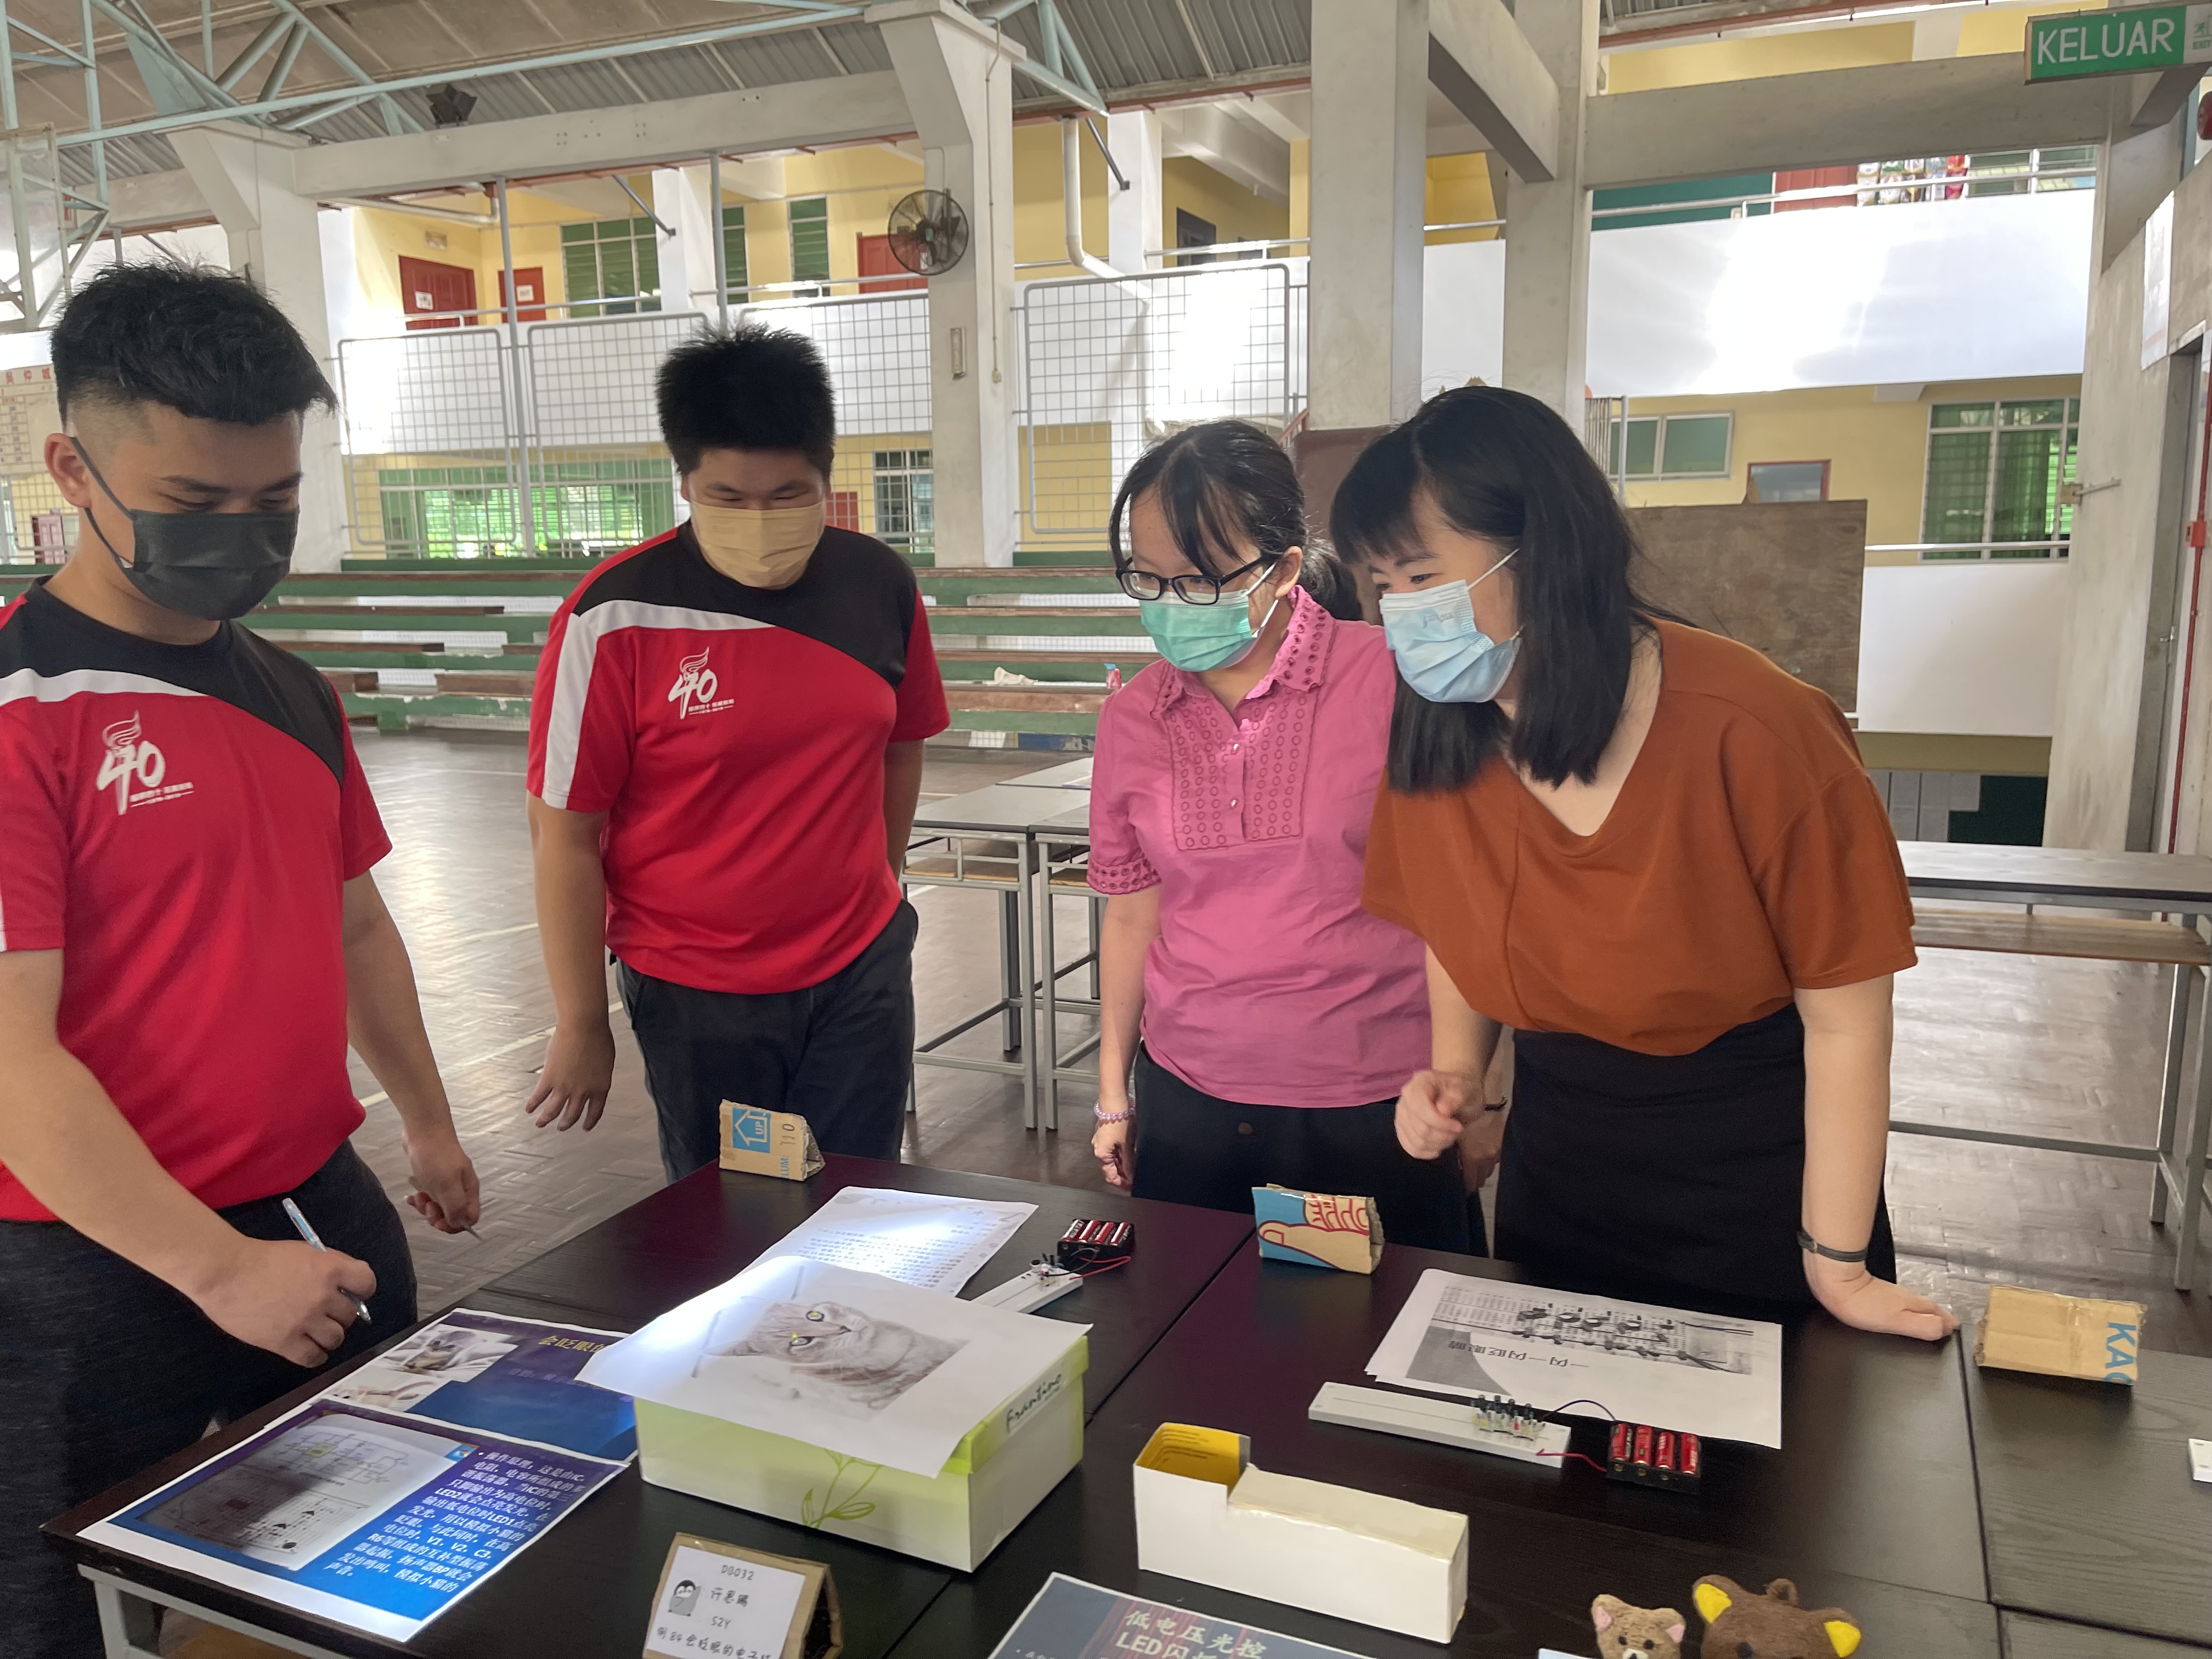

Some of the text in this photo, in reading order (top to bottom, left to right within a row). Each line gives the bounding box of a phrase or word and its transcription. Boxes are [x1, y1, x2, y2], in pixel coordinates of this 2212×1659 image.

[2037, 18, 2175, 65] KELUAR
[668, 668, 718, 720] 40
[97, 740, 166, 816] 40
[755, 1121, 764, 1135] UP
[1125, 1610, 1267, 1659] 低电压光控
